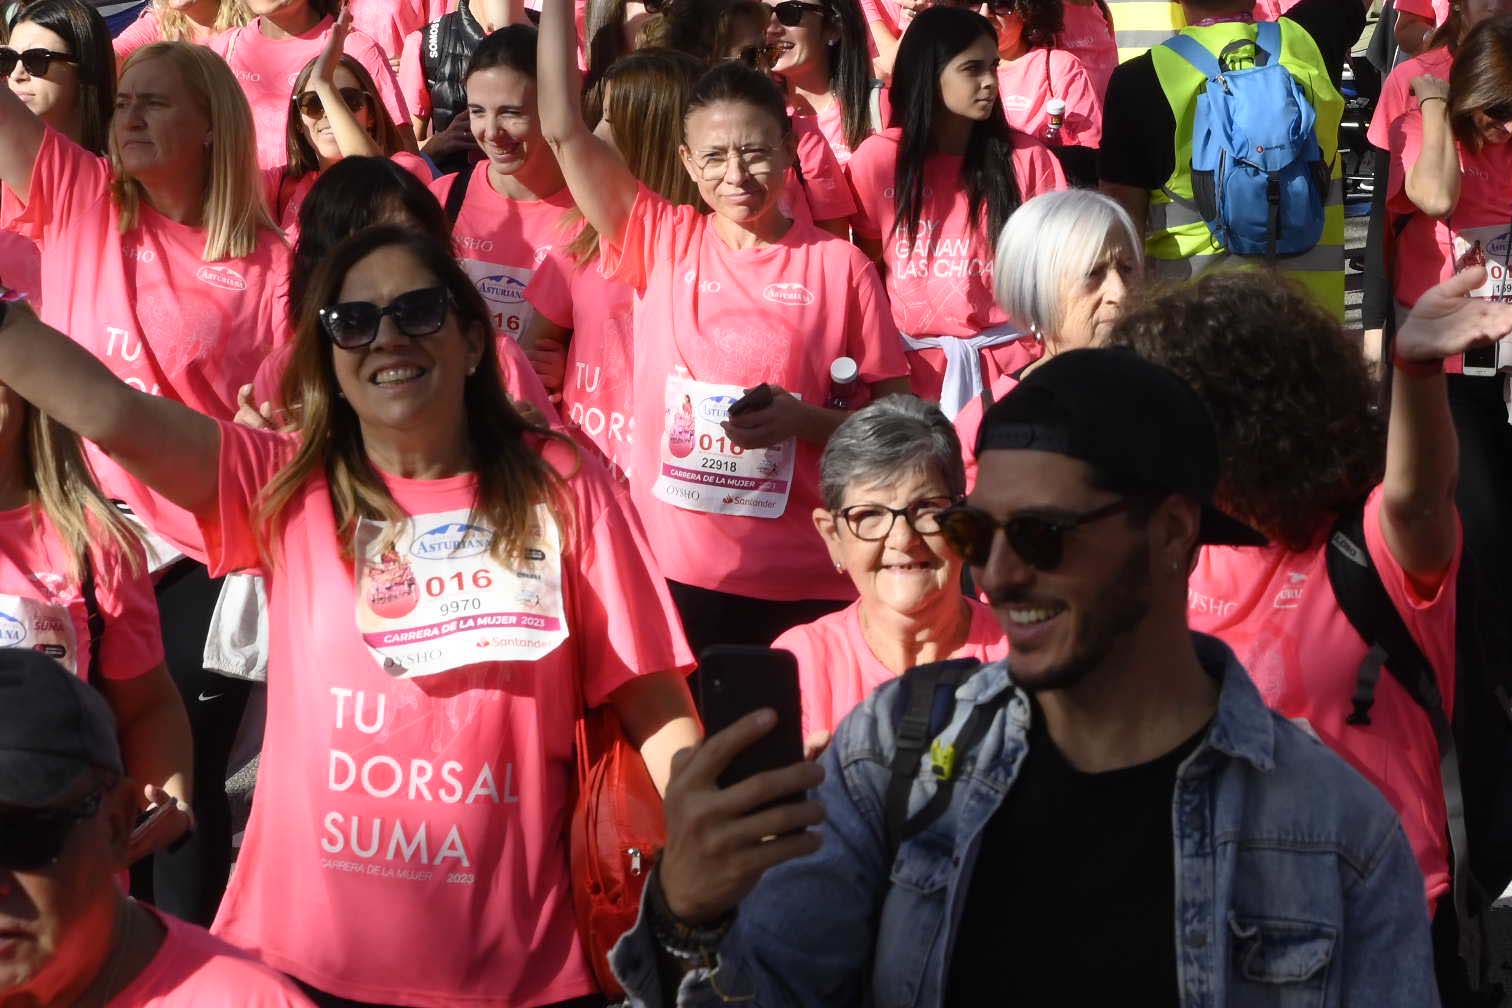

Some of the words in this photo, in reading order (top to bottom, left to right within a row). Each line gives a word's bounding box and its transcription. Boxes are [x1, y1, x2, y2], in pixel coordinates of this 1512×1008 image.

[895, 238, 970, 259] GANAN
[895, 258, 928, 280] LAS
[932, 257, 996, 280] CHICA
[478, 281, 523, 300] ASTURIAN
[493, 312, 520, 332] 16
[106, 326, 143, 362] TU
[575, 361, 601, 393] TU
[701, 457, 738, 473] 22918
[669, 468, 701, 481] CARRERA
[702, 473, 714, 483] DE
[715, 475, 727, 485] LA
[727, 477, 756, 488] MUJER
[666, 485, 701, 502] OYSHO
[733, 495, 777, 509] Santander
[424, 568, 494, 598] 016
[440, 597, 482, 617] 9970
[383, 628, 440, 644] CARRERA
[440, 624, 458, 635] DE
[458, 619, 475, 630] LA
[476, 615, 518, 627] MUJER
[520, 616, 545, 628] 2023
[395, 648, 443, 666] YSHO
[330, 686, 386, 734] TU
[328, 748, 519, 803] DORSAL
[320, 811, 471, 868] SUMA
[320, 857, 366, 873] CARRERA
[366, 865, 382, 875] DE
[382, 867, 395, 878] LA
[397, 869, 433, 881] MUJER
[446, 872, 475, 884] 2023
